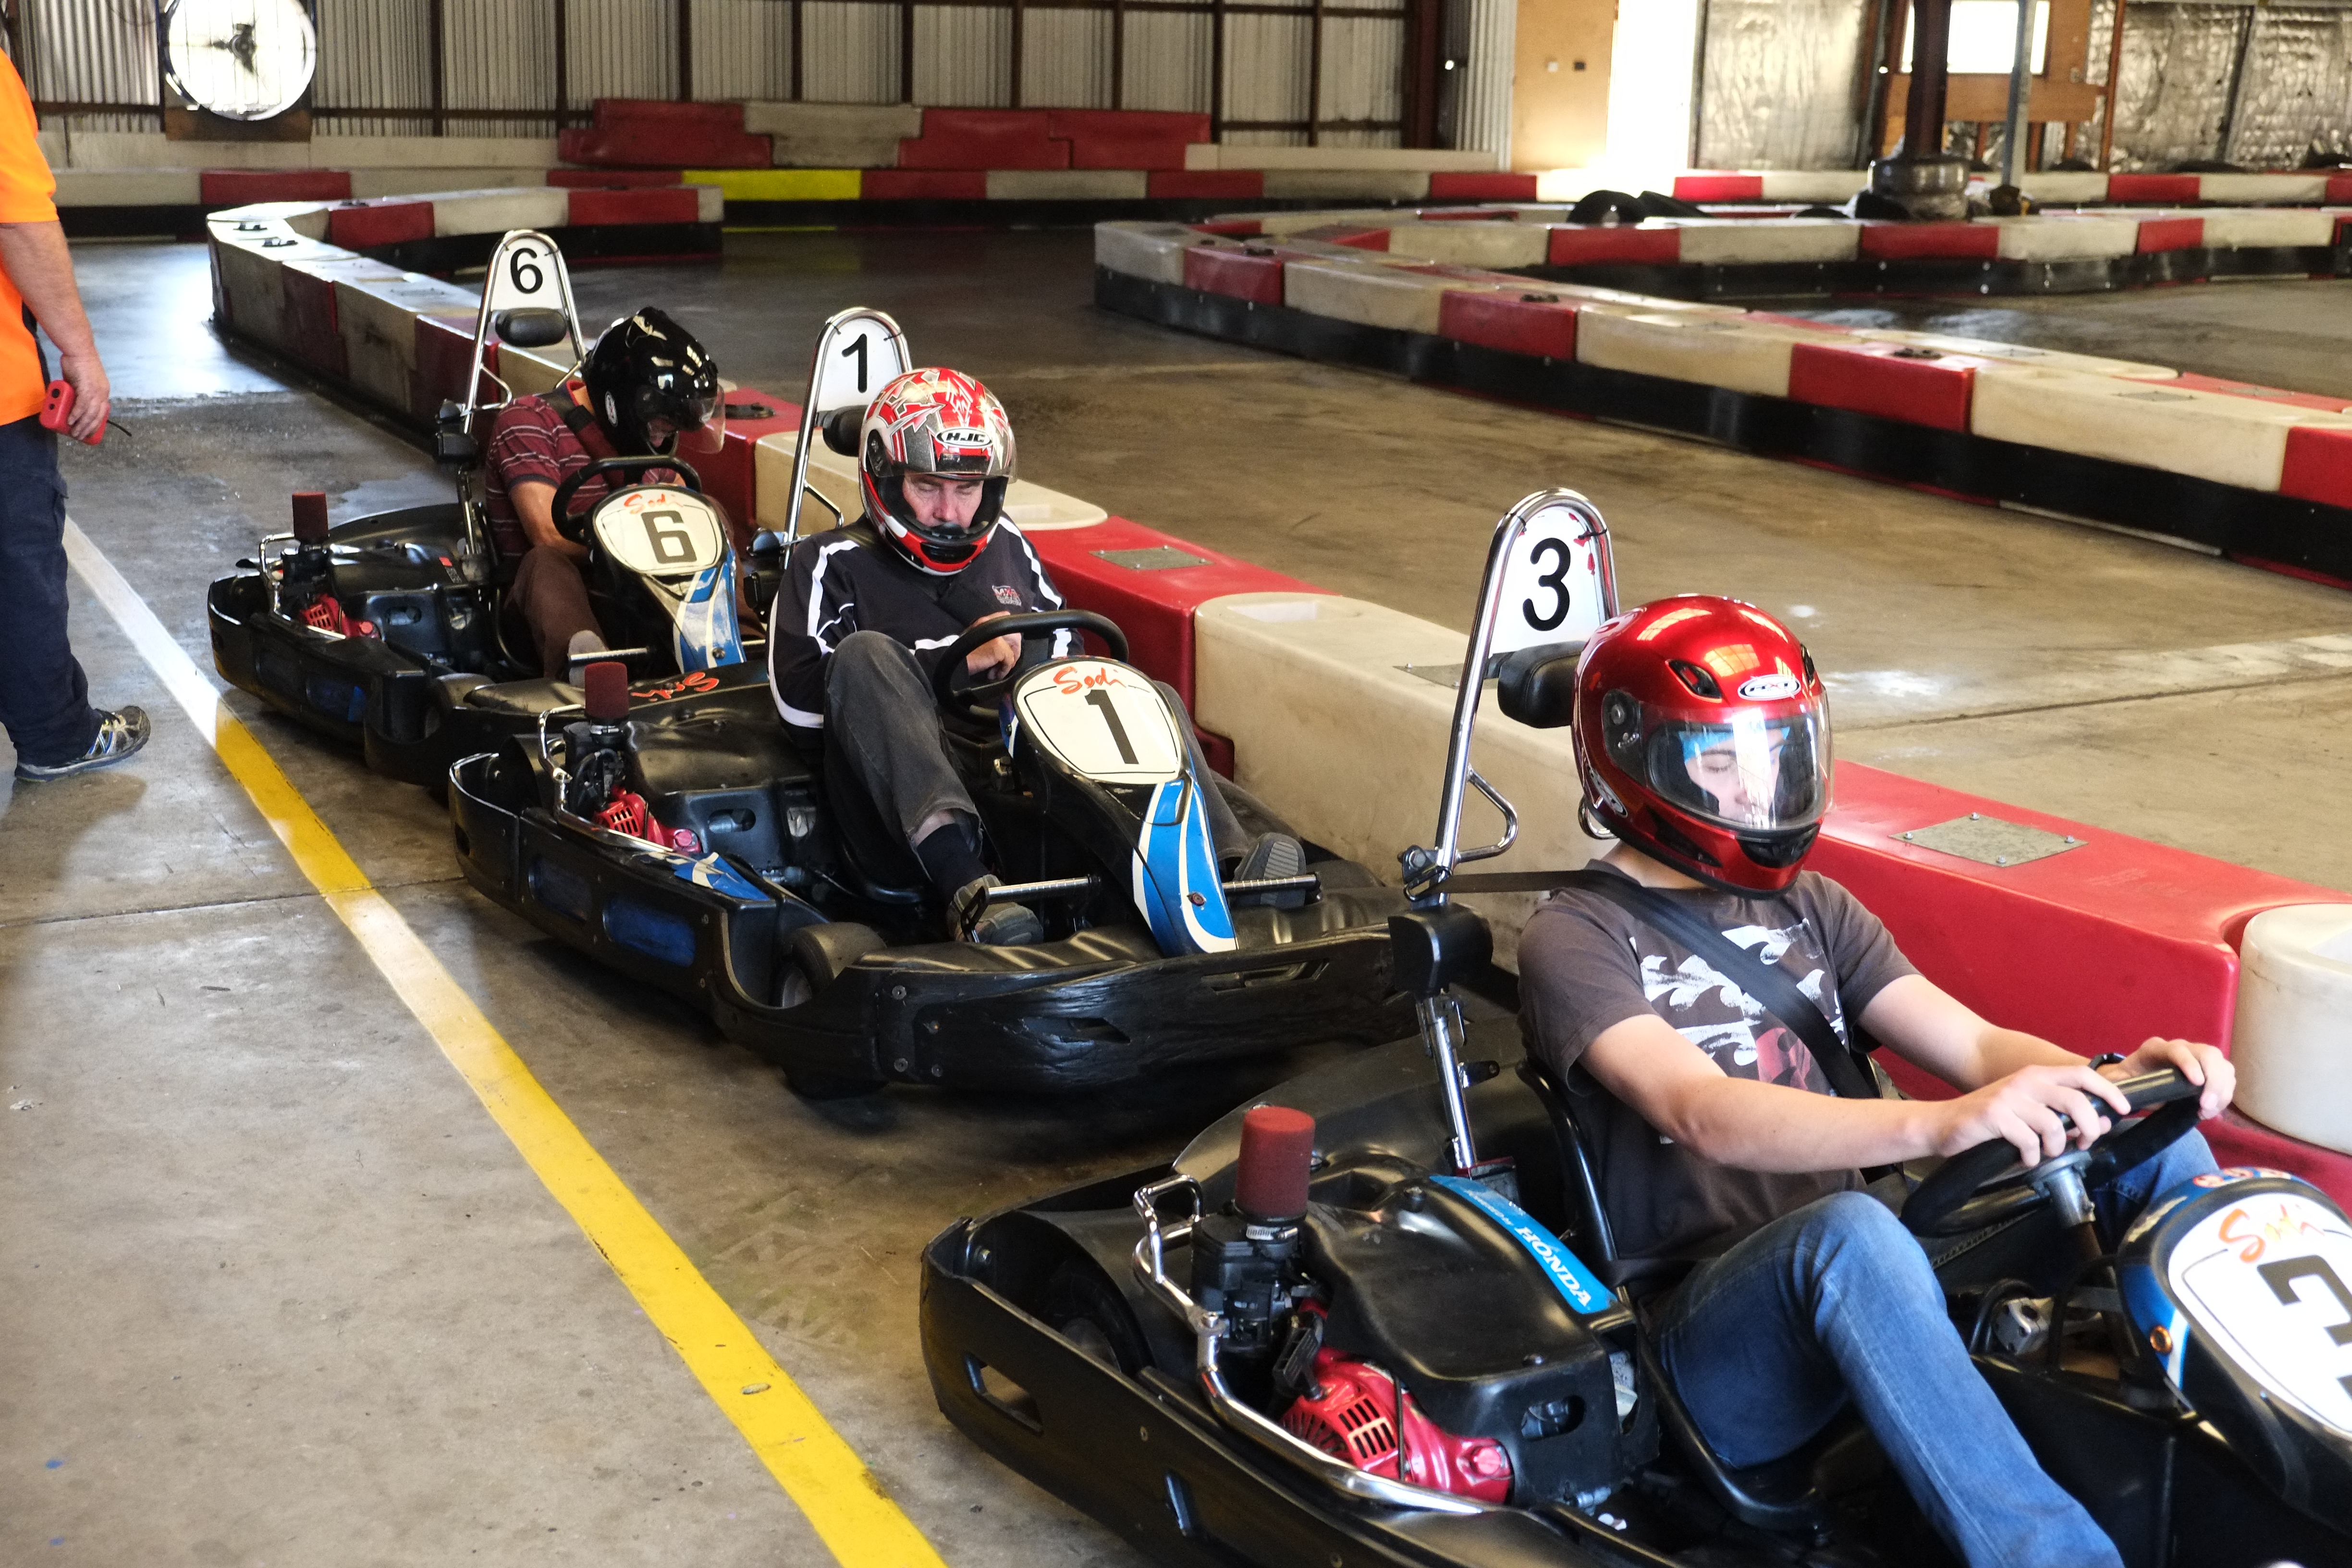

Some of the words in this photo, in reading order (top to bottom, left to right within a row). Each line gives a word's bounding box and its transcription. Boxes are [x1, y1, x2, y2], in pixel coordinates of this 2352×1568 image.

[510, 247, 543, 294] 6
[842, 333, 868, 393] 1
[945, 432, 986, 442] HJC
[640, 510, 698, 564] 6
[1522, 537, 1571, 632] 3
[1053, 665, 1127, 695] Sodi
[1084, 688, 1140, 765] 1
[2218, 1203, 2326, 1264] Sodi
[1514, 1226, 1592, 1307] HONDA
